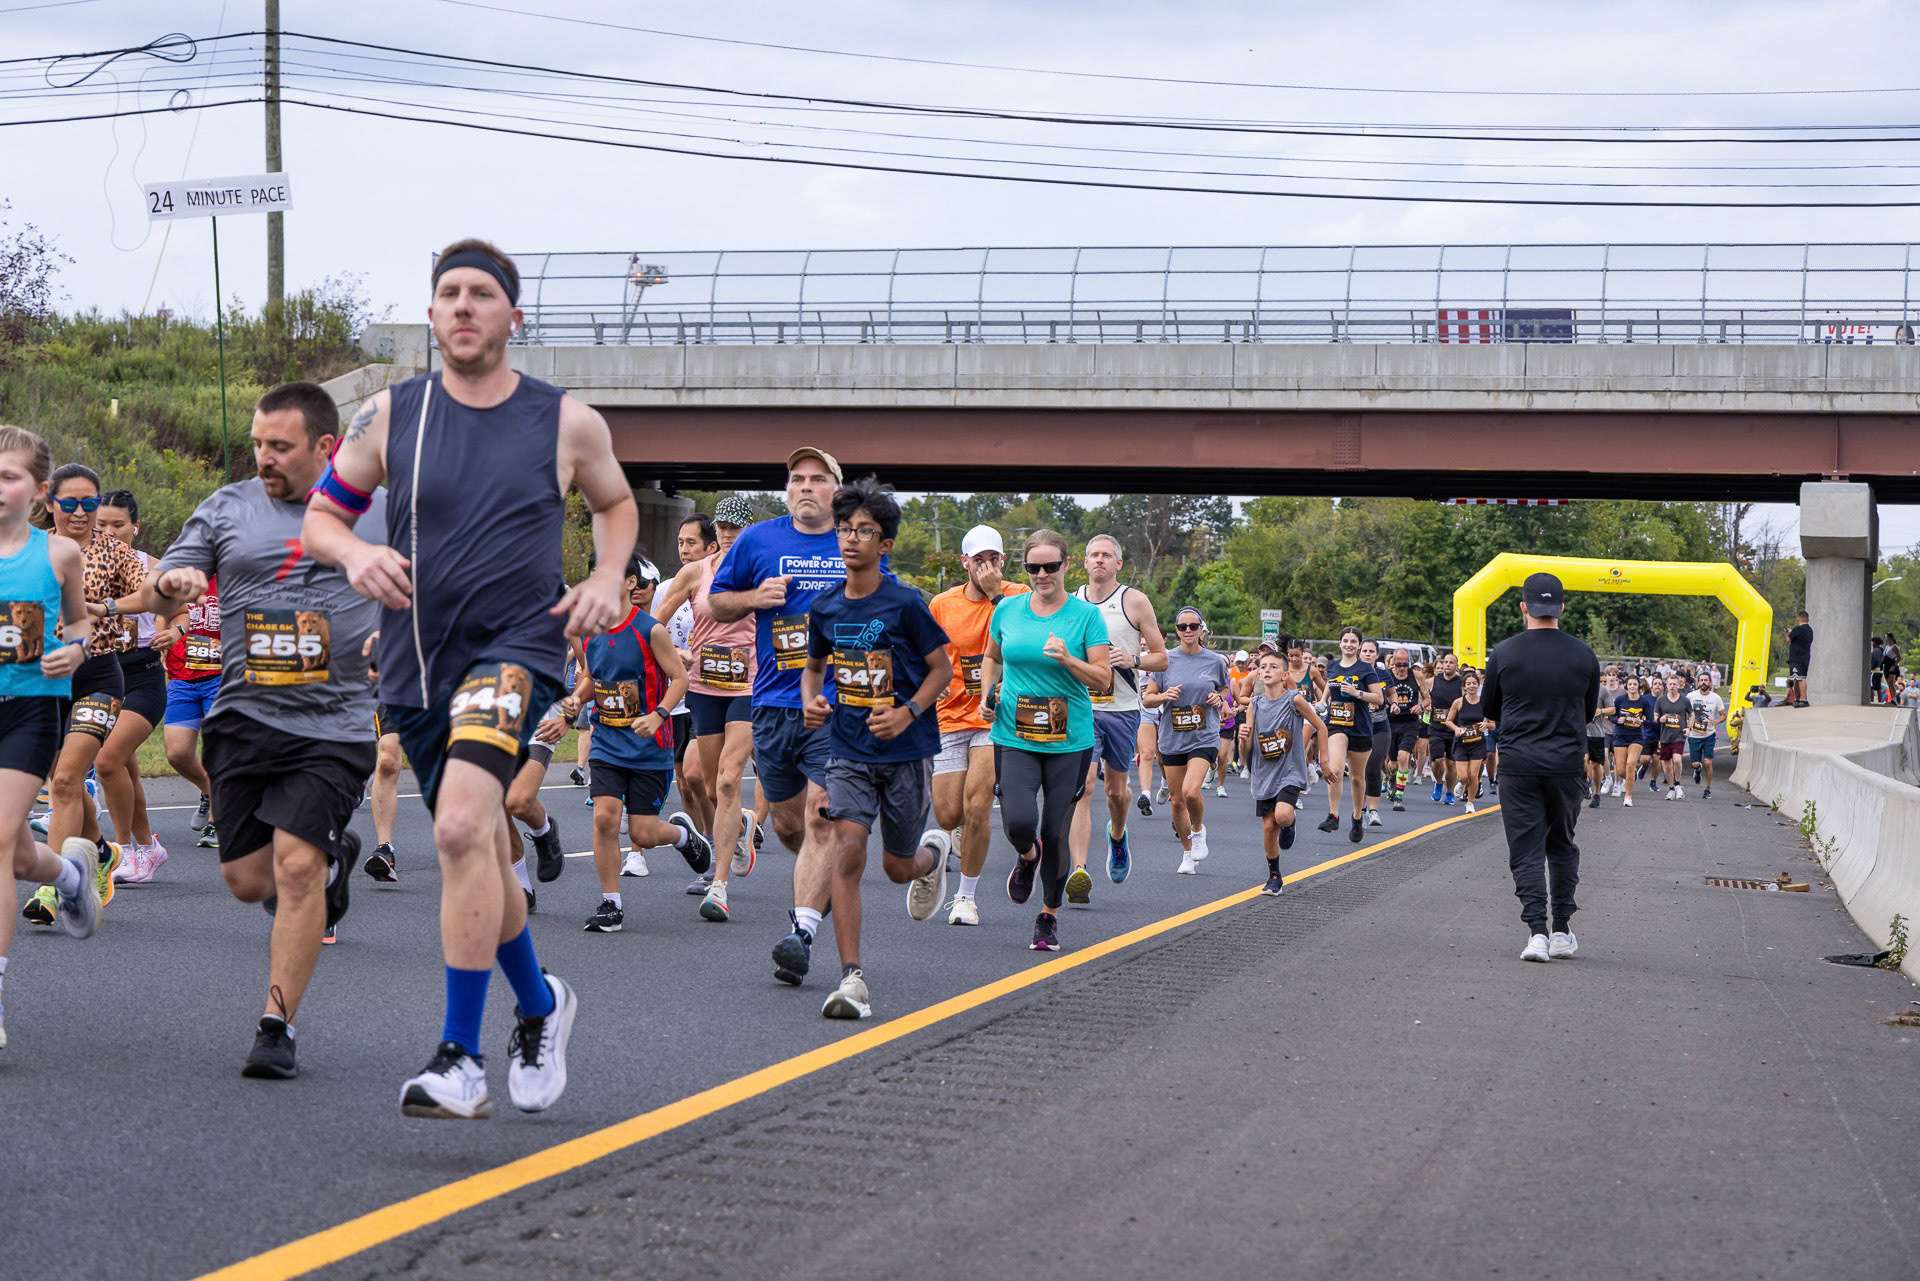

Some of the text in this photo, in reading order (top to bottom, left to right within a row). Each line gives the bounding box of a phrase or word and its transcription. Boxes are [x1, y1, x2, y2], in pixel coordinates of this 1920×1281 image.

[149, 186, 286, 213] 24 MINUTE PACE
[786, 559, 820, 568] POWER
[820, 560, 833, 568] OF
[796, 580, 825, 590] JDRF
[772, 625, 795, 633] CHASE
[250, 632, 322, 656] 255
[778, 632, 809, 649] 13
[703, 659, 745, 674] 253
[838, 668, 887, 686] 347
[603, 696, 625, 709] 41
[75, 707, 117, 730] 392
[1033, 711, 1049, 725] 2
[1176, 714, 1202, 725] 128
[1332, 708, 1351, 717] 193
[1262, 738, 1287, 752] 127
